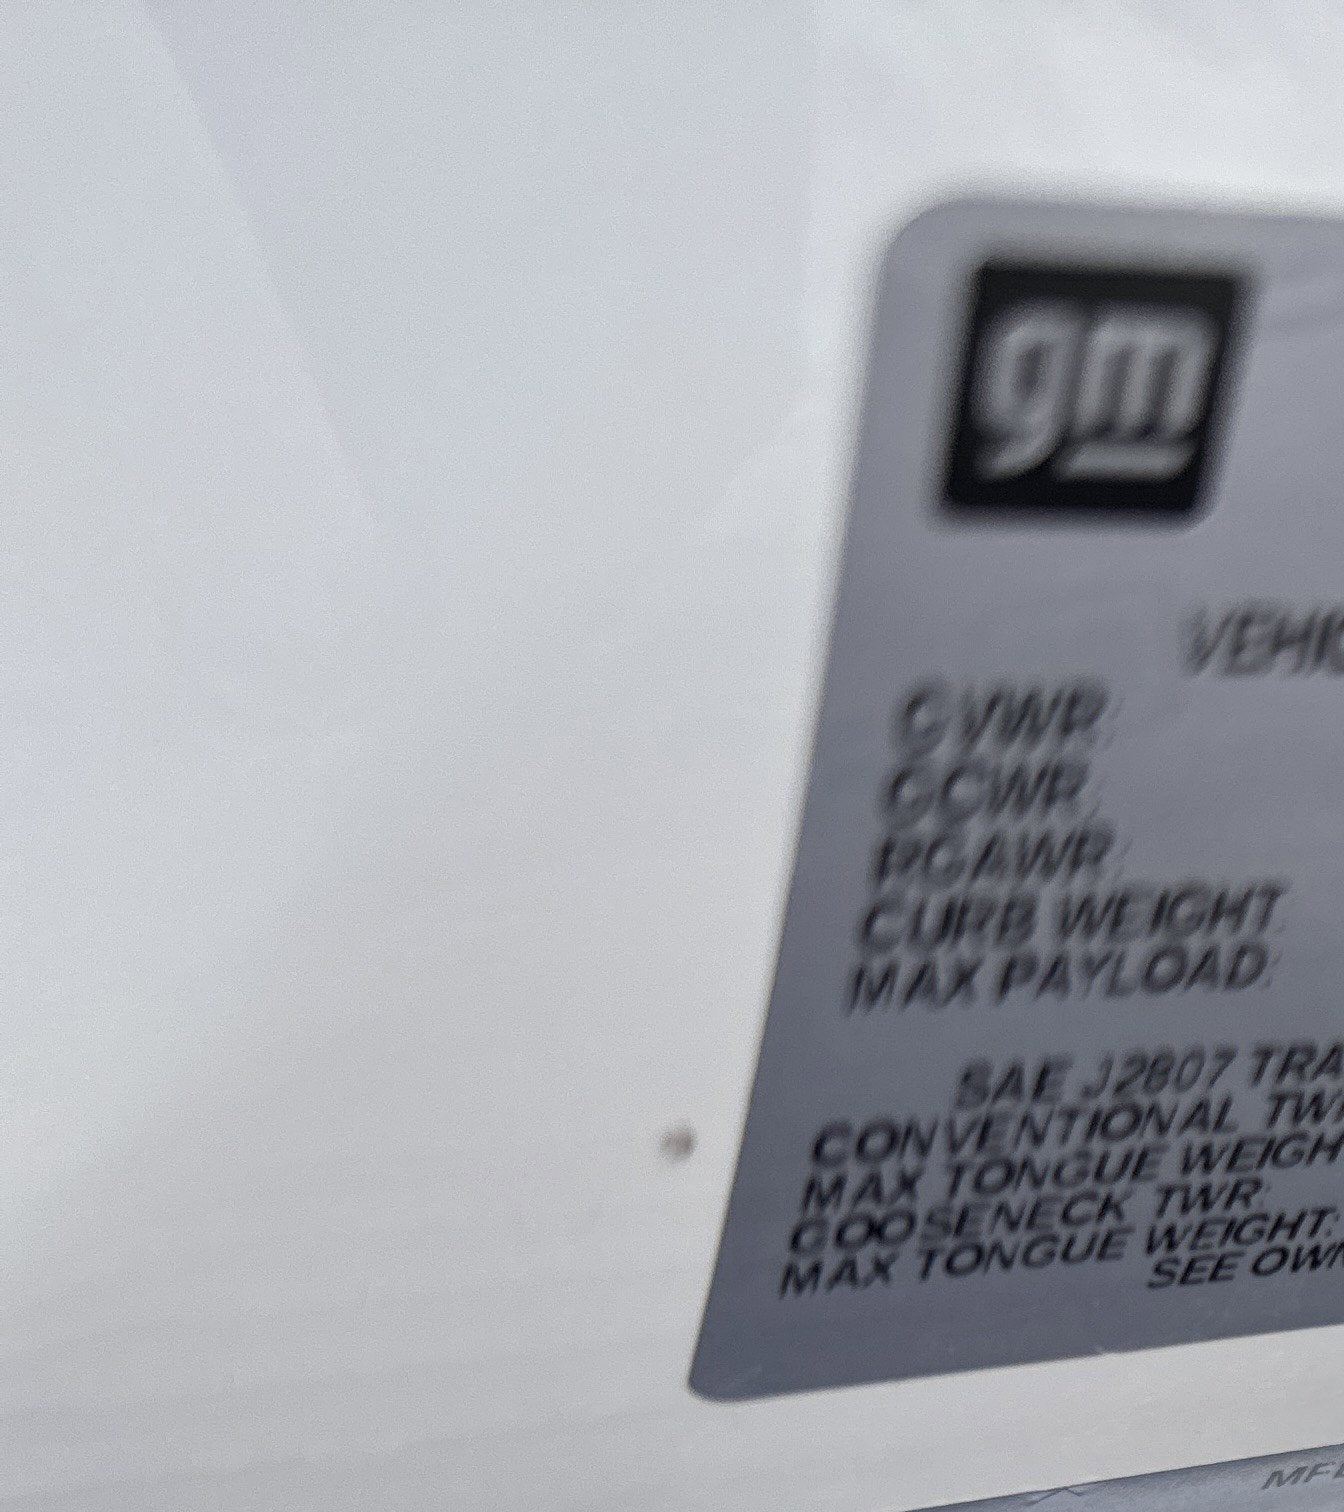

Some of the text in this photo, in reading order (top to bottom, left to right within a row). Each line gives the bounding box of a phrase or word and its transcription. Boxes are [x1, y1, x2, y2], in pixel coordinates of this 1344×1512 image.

[982, 304, 1218, 480] gm
[856, 896, 1040, 958] CURB
[842, 956, 986, 1016] MAX
[952, 1054, 1074, 1112] SAE
[1076, 1042, 1240, 1102] J2807
[808, 1094, 1244, 1172] CONVENTIONAL
[798, 1166, 926, 1216] MAX
[938, 1142, 1172, 1202] TONGUE
[778, 1204, 1344, 1300] MAX TONGUE WEIGHT:
[784, 1190, 1136, 1258] GOOSENECK
[1144, 1248, 1242, 1290] SEE
